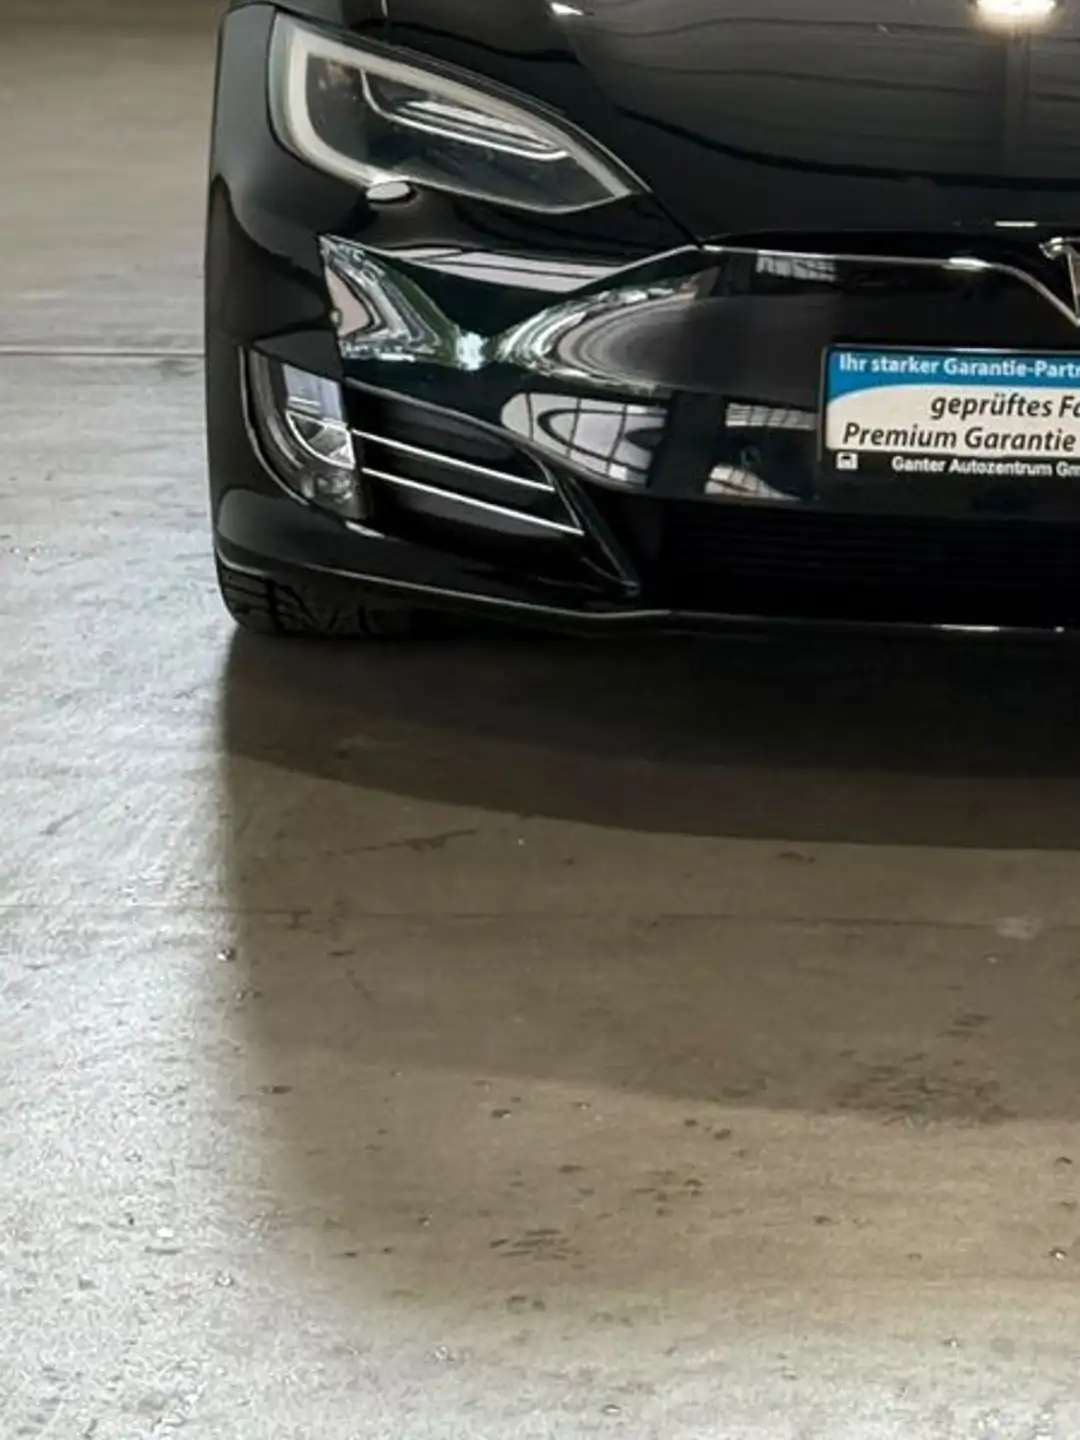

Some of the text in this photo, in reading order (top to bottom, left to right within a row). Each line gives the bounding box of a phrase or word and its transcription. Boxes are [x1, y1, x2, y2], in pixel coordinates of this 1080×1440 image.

[839, 354, 866, 373] Ihr
[870, 357, 939, 375] starker
[930, 393, 1053, 421] geprüftes
[842, 422, 1076, 452] Premium Garantie
[891, 456, 946, 473] Ganter
[949, 458, 1052, 477] Autozentrum
